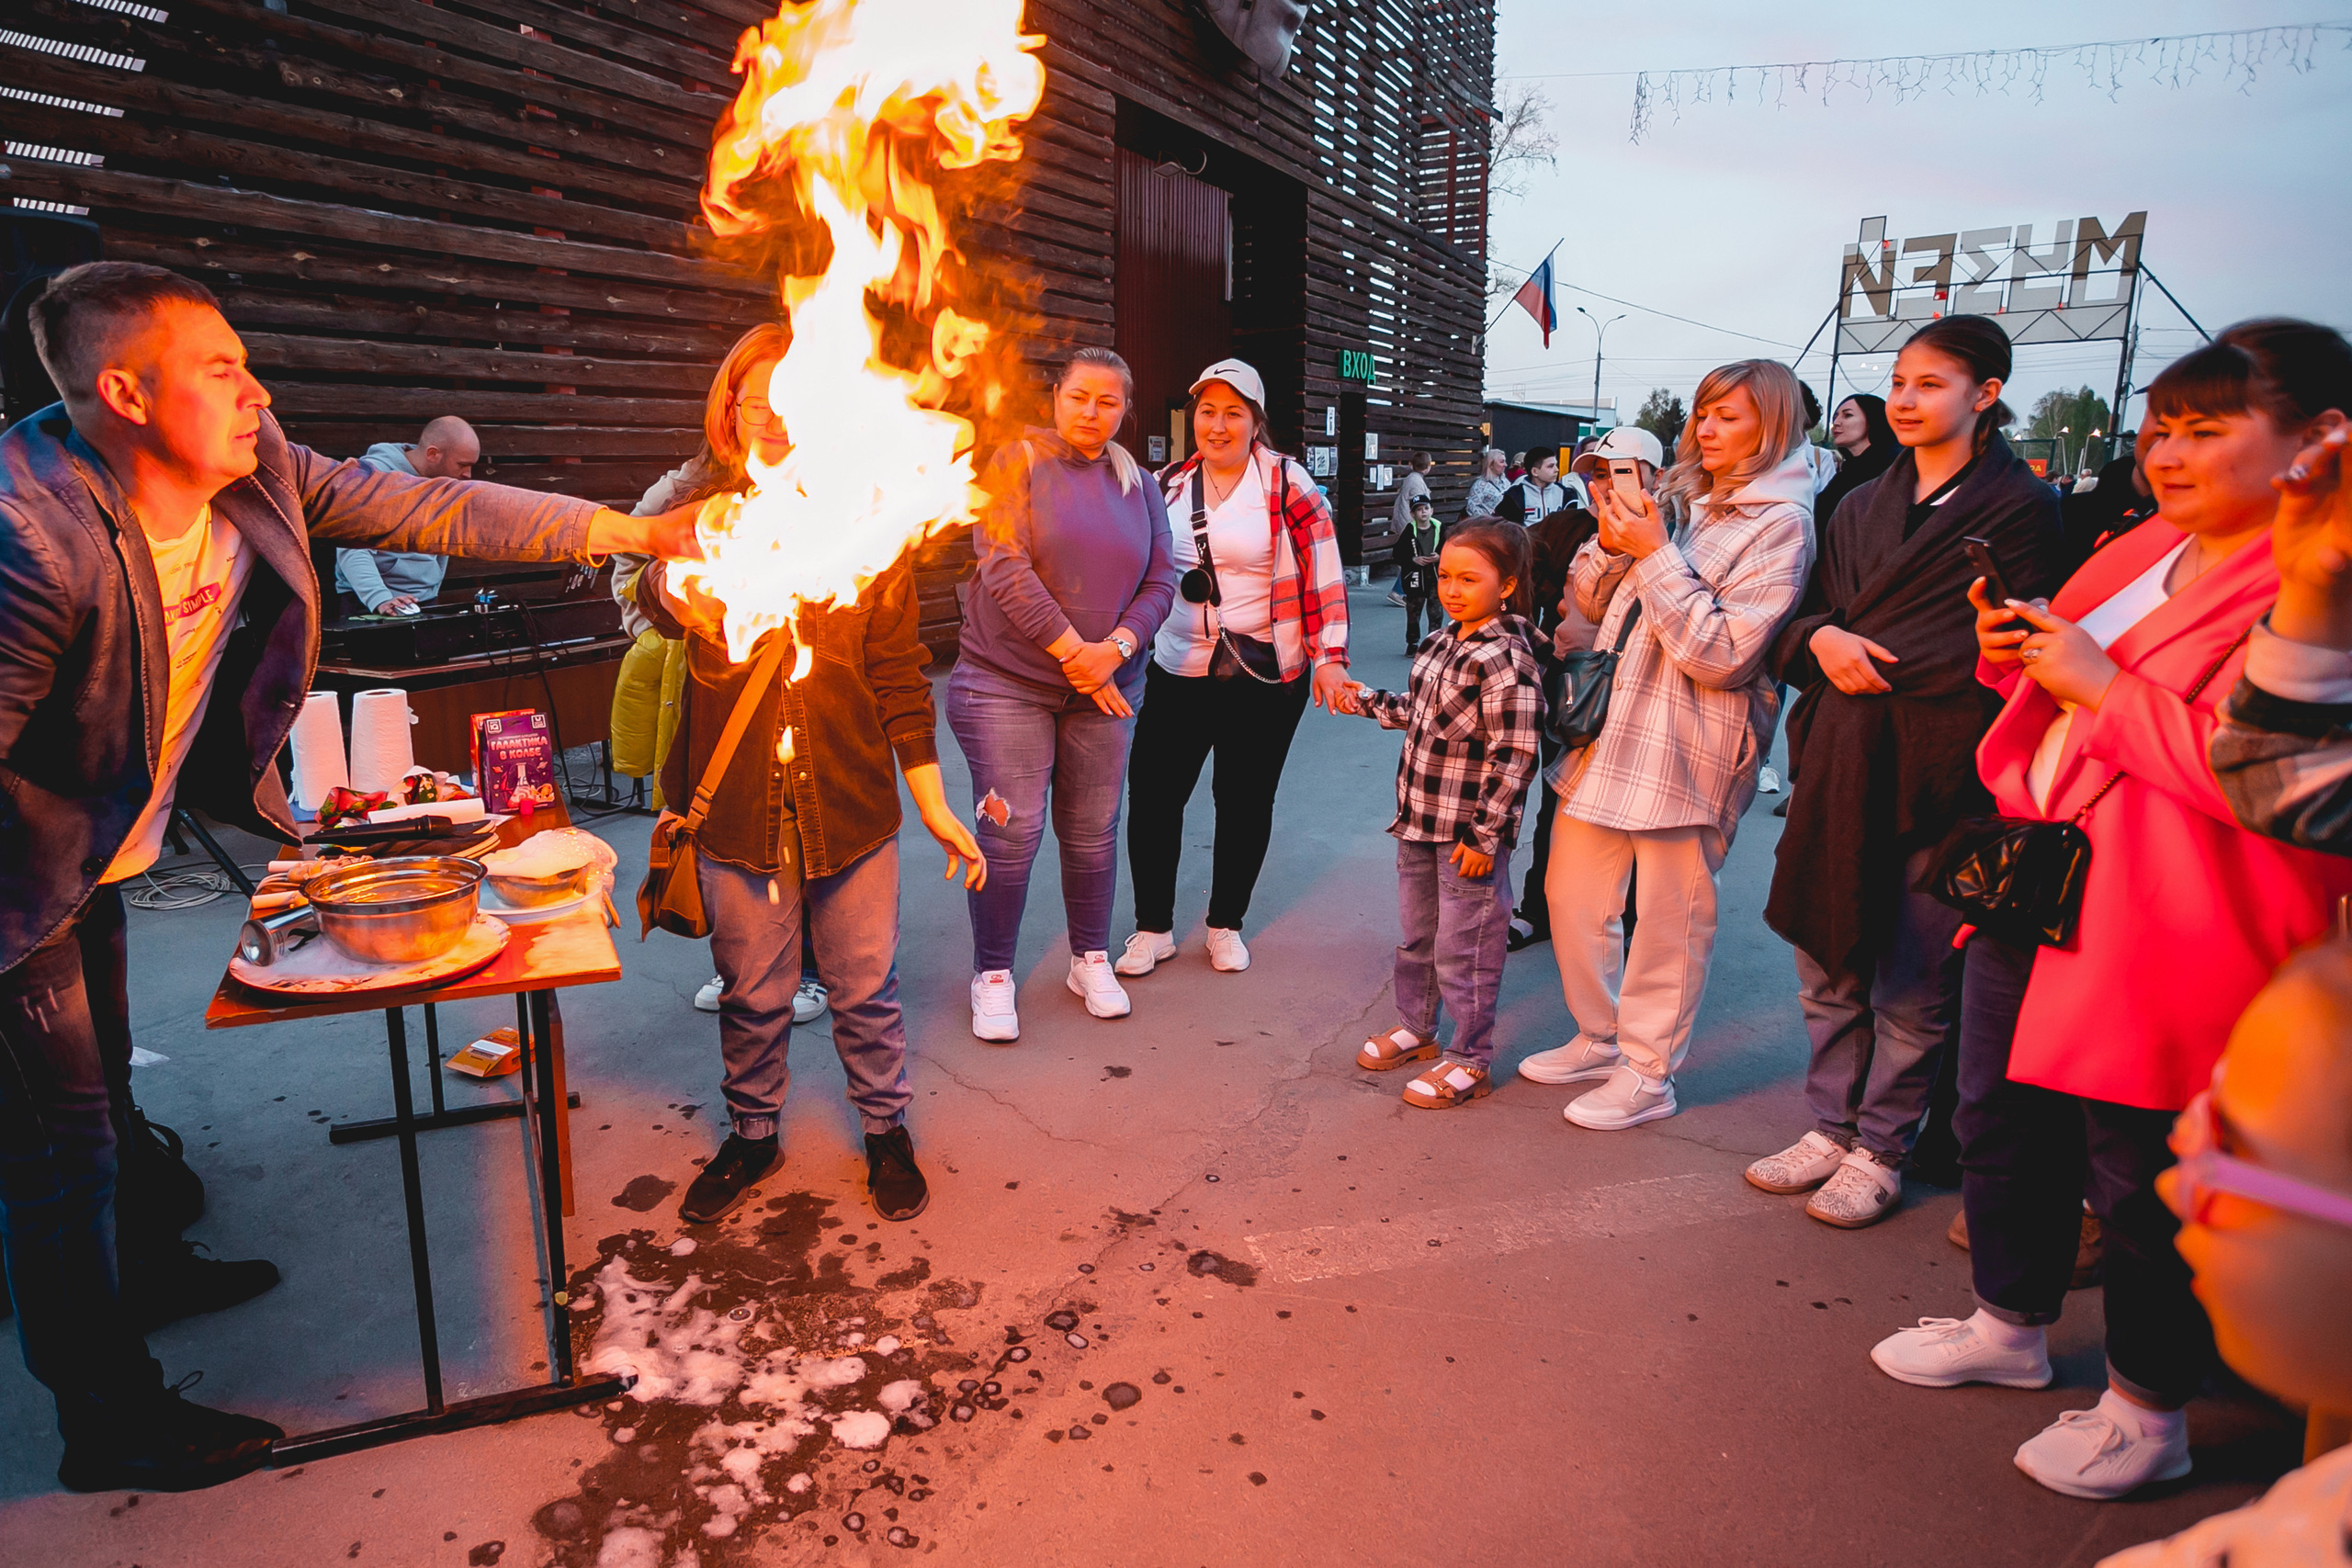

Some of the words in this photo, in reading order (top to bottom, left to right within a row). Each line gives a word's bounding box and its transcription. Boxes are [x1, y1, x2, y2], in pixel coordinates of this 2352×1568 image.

[1342, 349, 1376, 385] ВХОД
[182, 589, 214, 614] SIMPLE
[491, 736, 548, 751] ГАЛАКТИКА
[499, 750, 507, 761] В
[508, 747, 542, 761] КОЛБЕ
